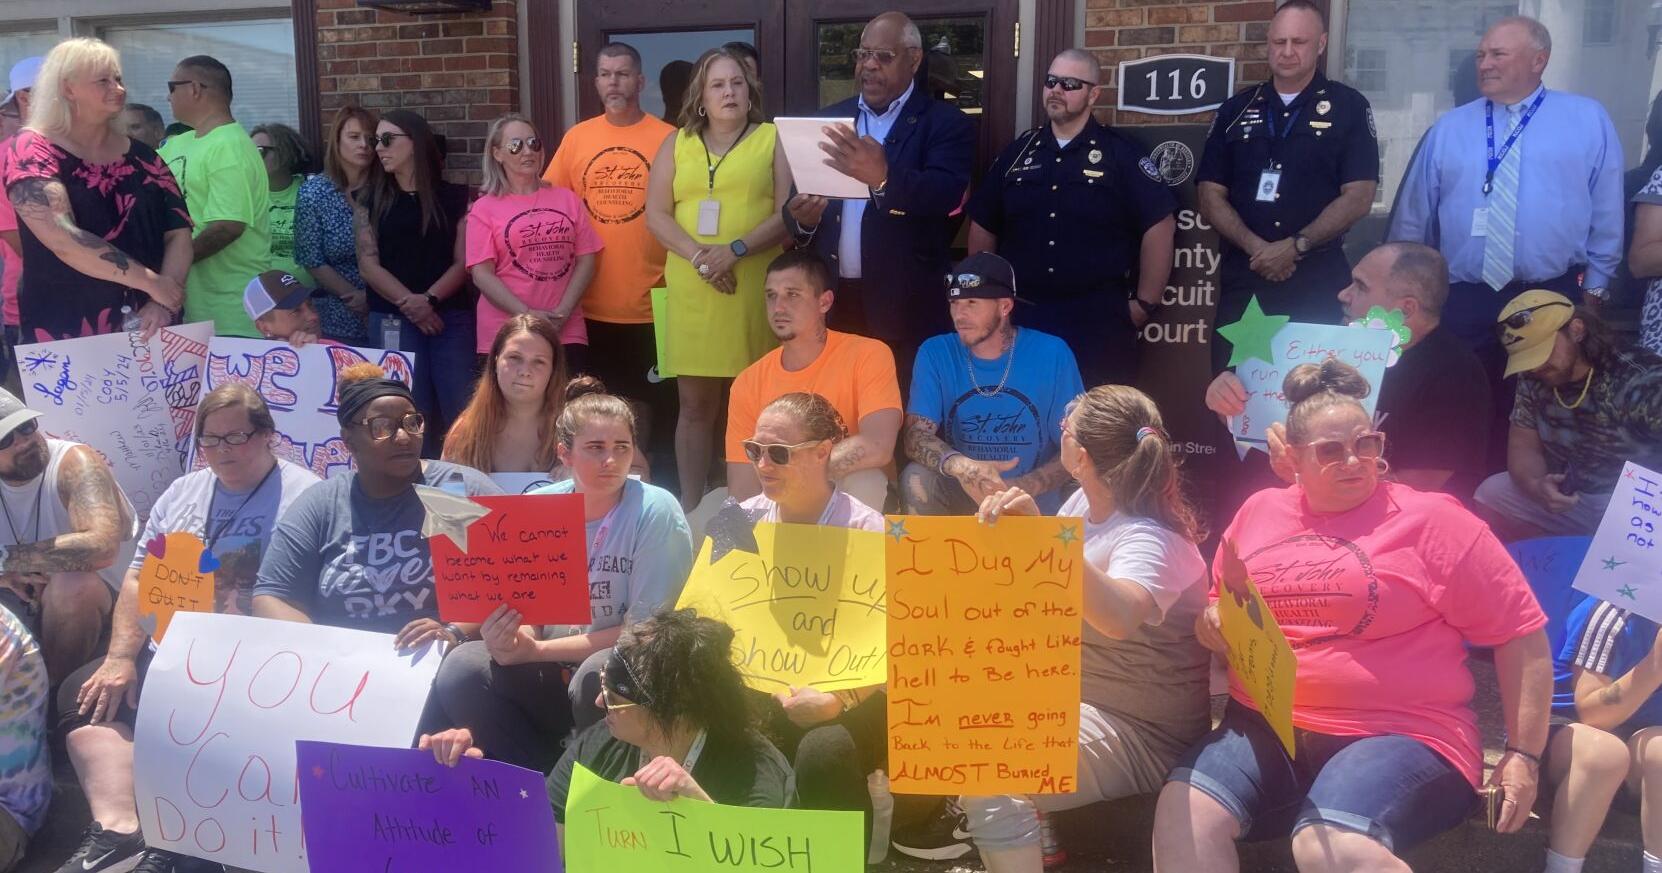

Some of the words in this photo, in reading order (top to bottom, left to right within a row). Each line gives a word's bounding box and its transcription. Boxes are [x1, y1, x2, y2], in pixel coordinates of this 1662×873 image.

[1145, 68, 1207, 101] 116
[595, 165, 618, 180] St.
[617, 162, 643, 180] John
[520, 222, 541, 238] St.
[546, 217, 570, 236] John
[1174, 243, 1221, 275] nty
[1161, 280, 1215, 306] cuit
[1137, 318, 1208, 344] ourt
[1353, 351, 1386, 368] you
[209, 346, 300, 406] WE
[1251, 369, 1279, 381] run
[960, 413, 992, 433] St.
[993, 406, 1027, 433] John
[481, 513, 508, 545] We
[519, 529, 569, 543] cannot
[1627, 533, 1655, 549] not
[343, 529, 420, 566] FBC
[446, 555, 495, 567] become
[504, 554, 540, 564] what
[548, 552, 568, 562] we
[896, 536, 934, 576] I
[944, 538, 1015, 586] Dug
[1025, 547, 1073, 589] My
[1251, 560, 1299, 584] St.
[1296, 551, 1352, 583] John
[155, 564, 204, 590] DON'T
[442, 573, 476, 582] want
[481, 573, 500, 585] by
[507, 572, 567, 585] remaining
[1259, 582, 1344, 594] ECOVERY
[448, 591, 480, 601] what
[488, 592, 504, 601] we
[511, 590, 537, 600] are
[889, 588, 949, 620] Soul
[964, 602, 1002, 621] out
[1013, 601, 1037, 618] of
[1042, 600, 1078, 618] the
[1267, 599, 1330, 609] EHAVIORAL
[793, 608, 837, 640] and
[1278, 618, 1334, 628] UNSELING
[893, 665, 936, 689] hell
[949, 668, 970, 684] to
[983, 666, 1015, 682] Be
[1027, 708, 1067, 730] going
[891, 736, 930, 751] Back
[944, 739, 960, 750] to
[968, 738, 993, 750] the
[1042, 736, 1074, 748] that
[185, 732, 300, 808] Ca
[328, 750, 441, 794] Cultivate
[472, 776, 500, 800] AN
[890, 762, 989, 784] ALMOST
[1038, 776, 1073, 794] ME
[155, 796, 227, 853] Do
[373, 813, 457, 846] Attitude
[477, 822, 499, 846] of
[659, 811, 692, 858] I
[708, 831, 812, 873] WISH
